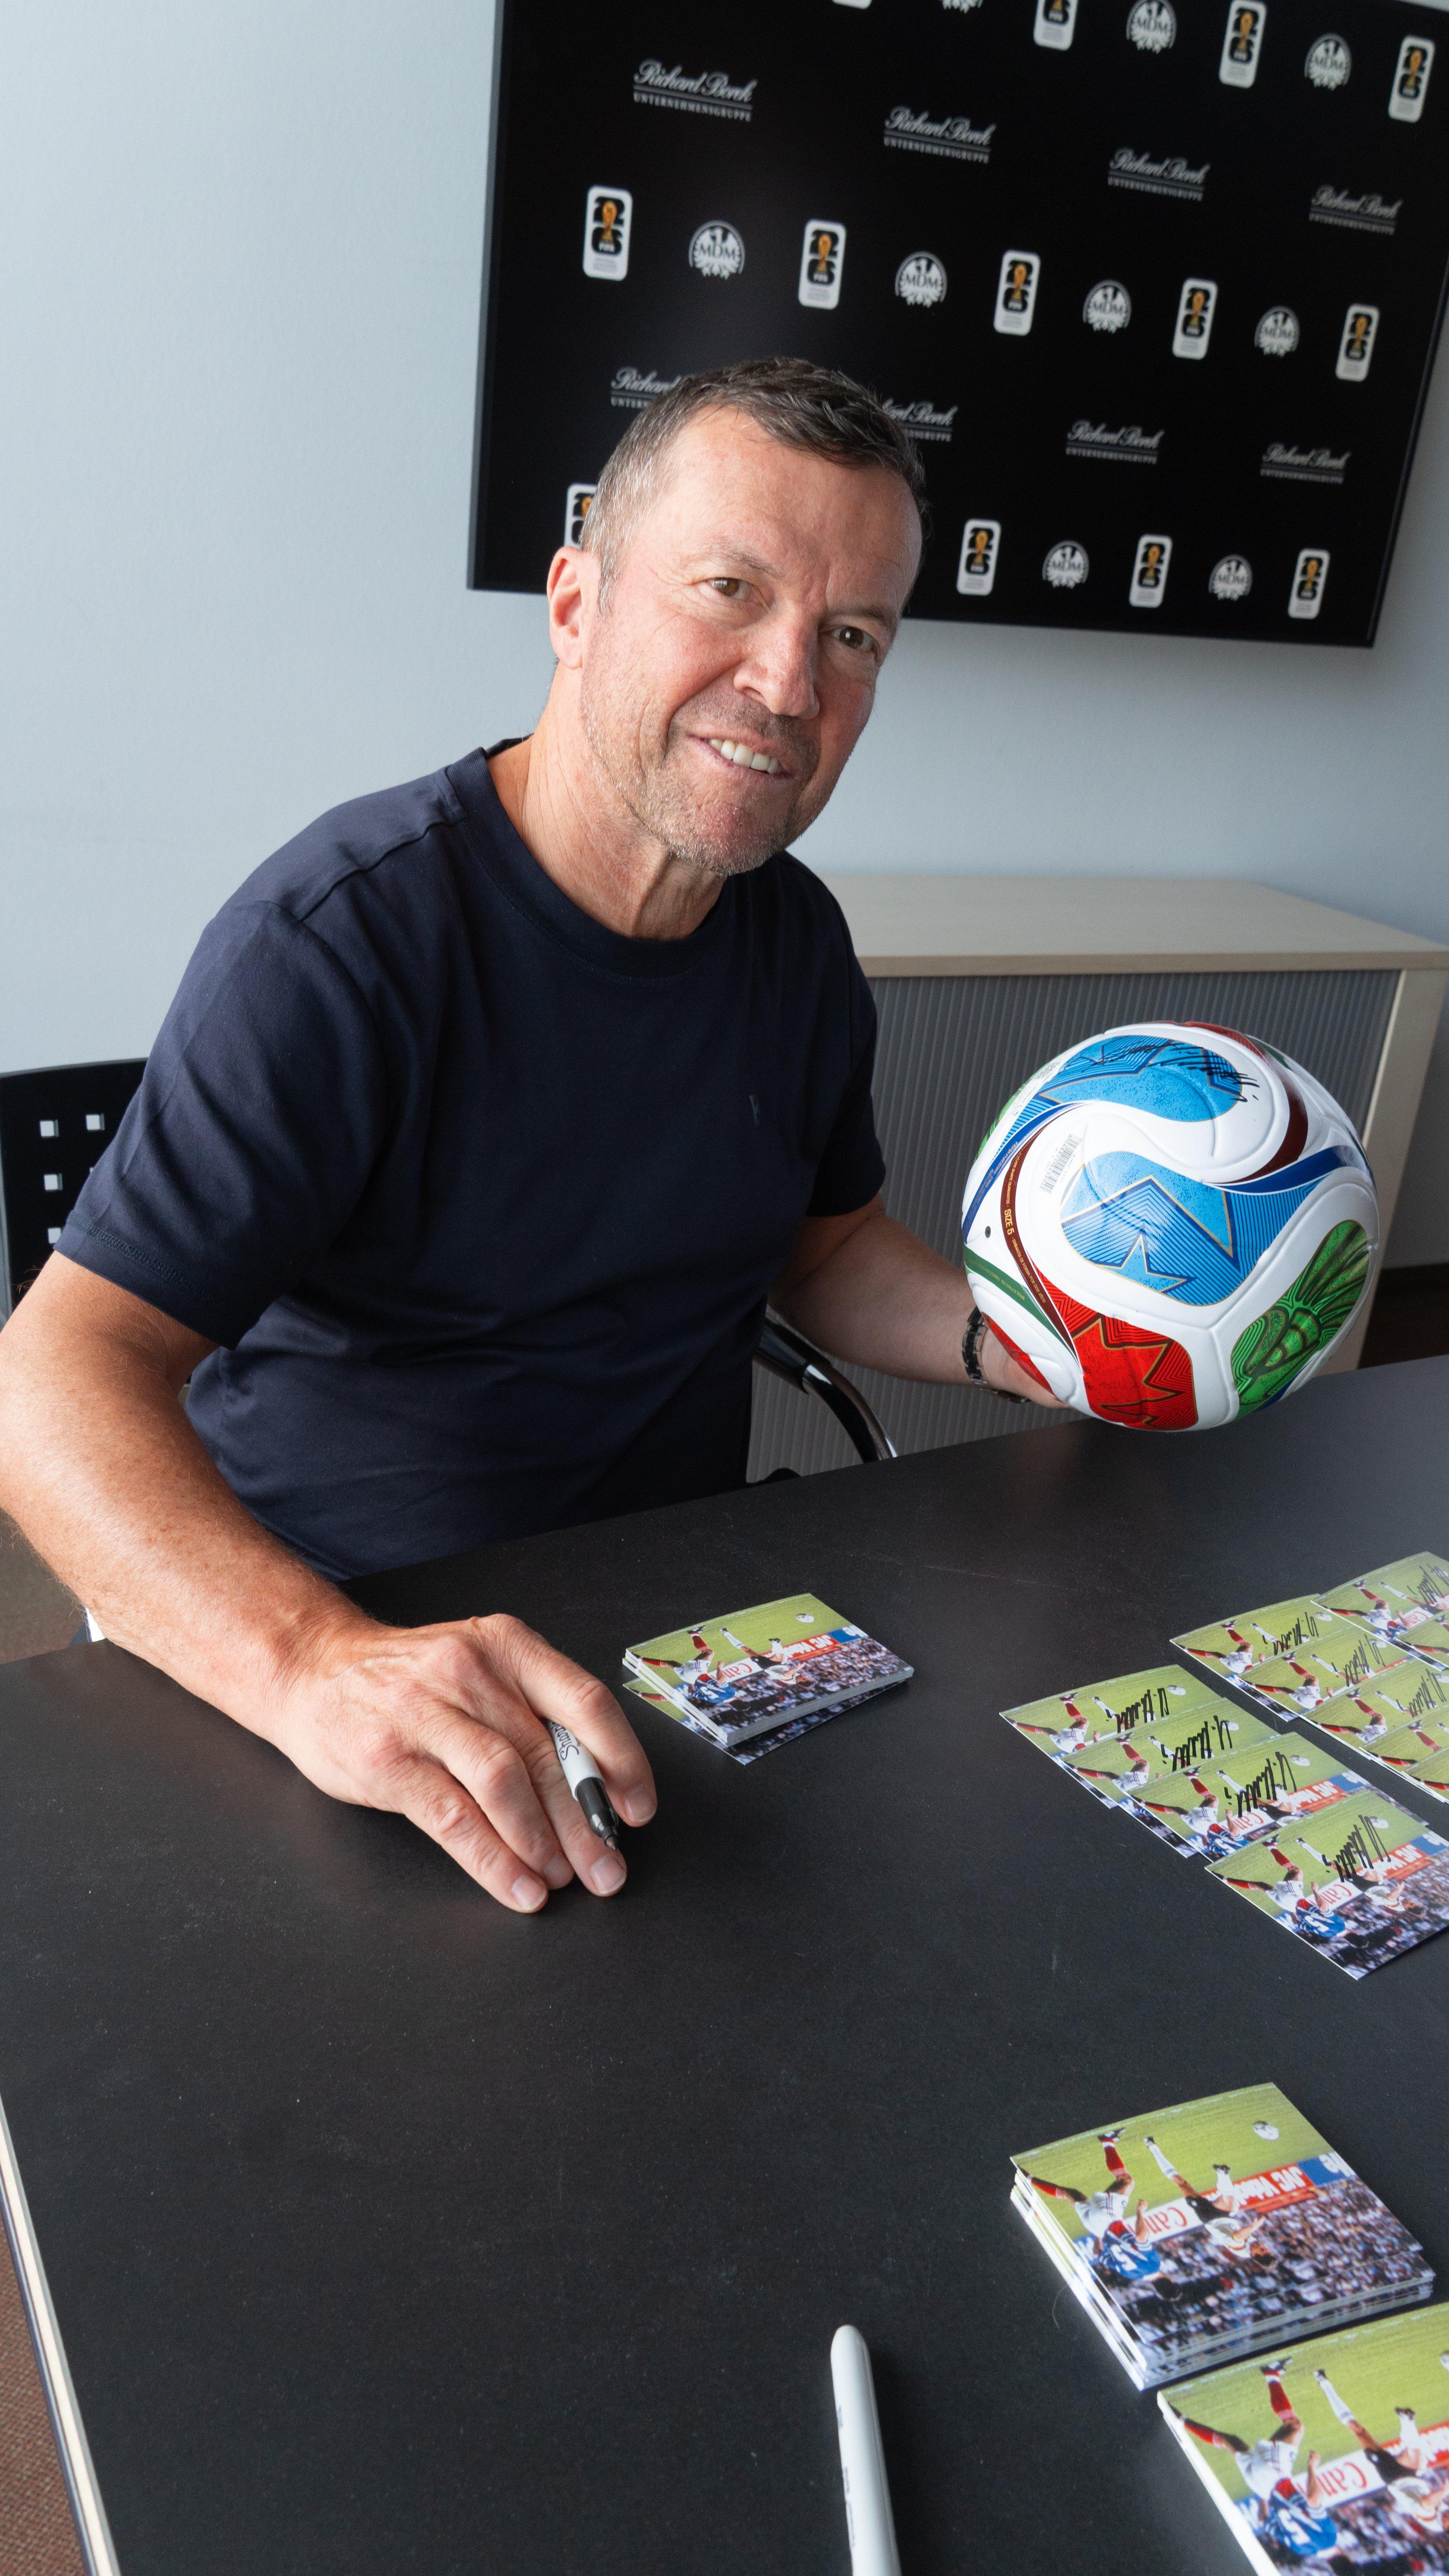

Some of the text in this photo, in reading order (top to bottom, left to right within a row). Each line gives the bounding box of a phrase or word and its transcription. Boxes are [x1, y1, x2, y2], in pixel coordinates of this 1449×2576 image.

[634, 59, 707, 94] Richard
[885, 106, 952, 137] Richard
[1004, 1209, 1012, 1228] SIZE
